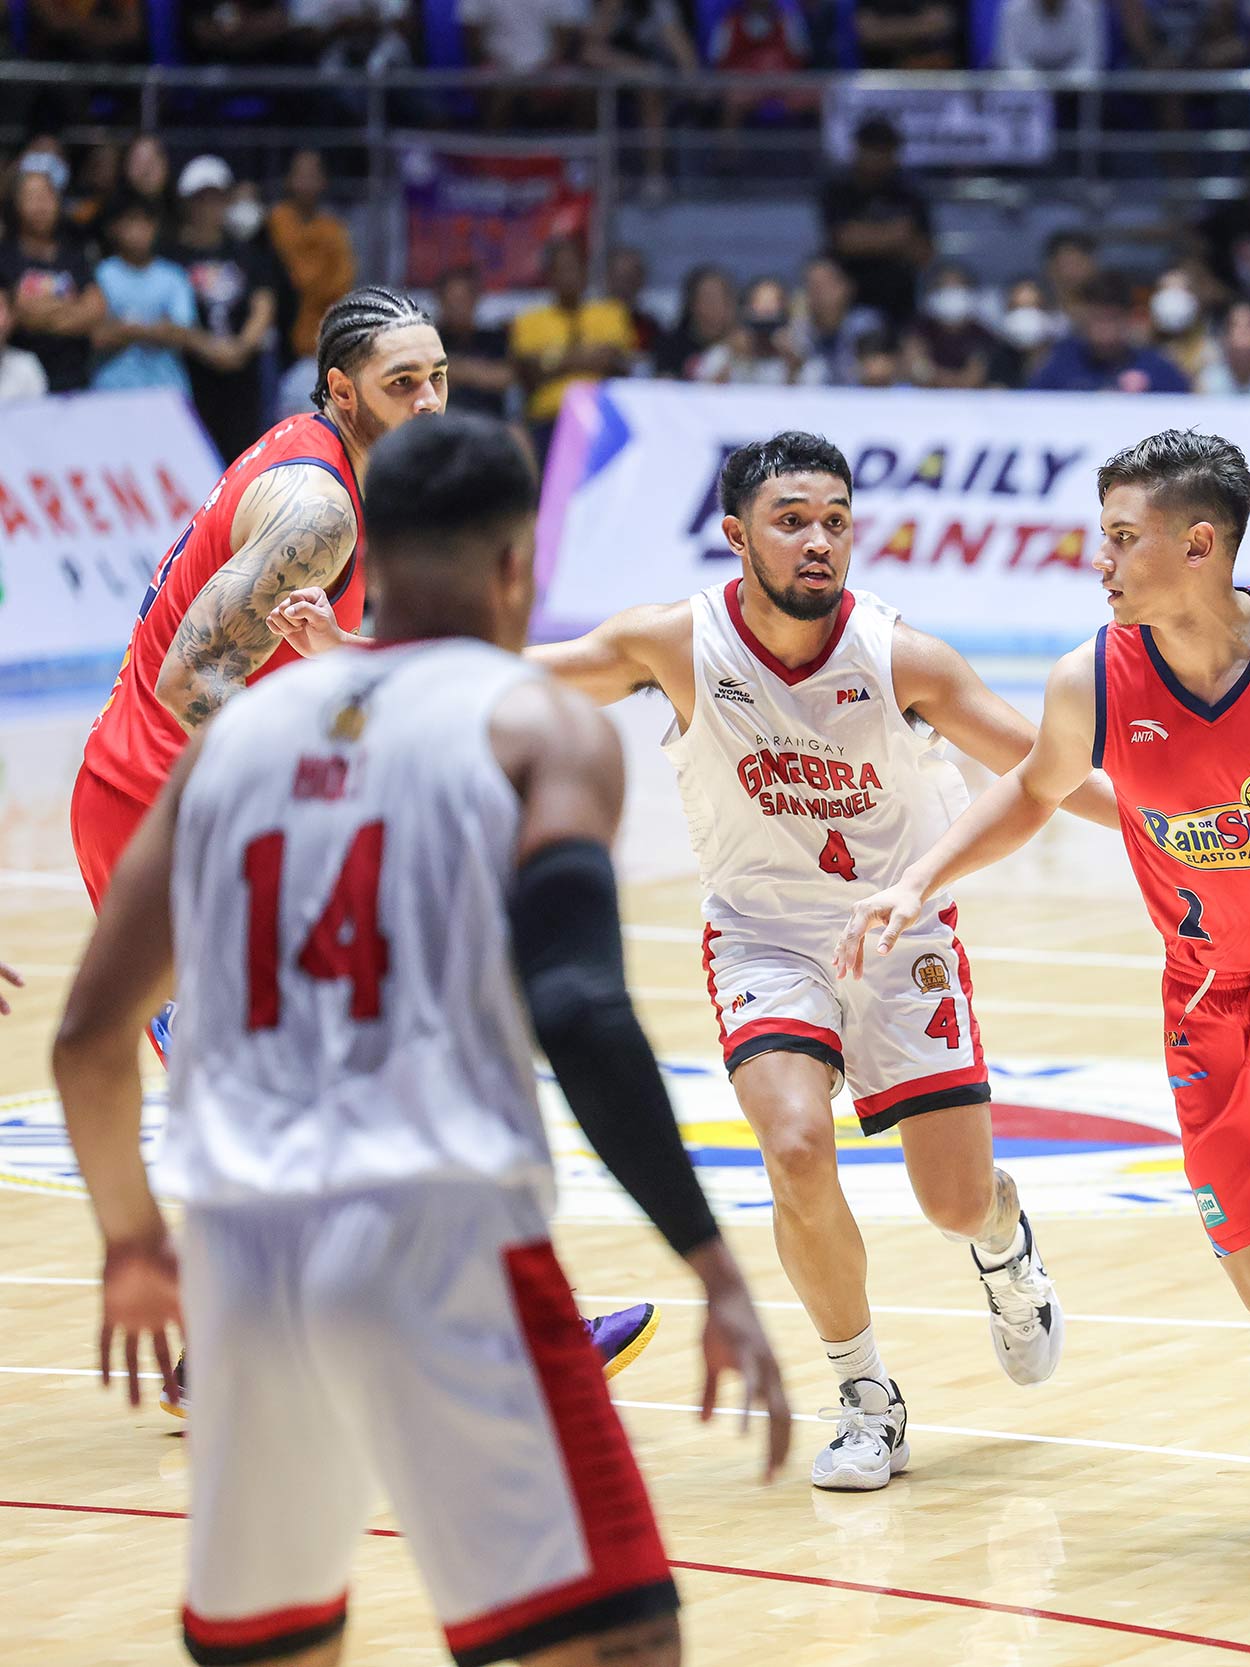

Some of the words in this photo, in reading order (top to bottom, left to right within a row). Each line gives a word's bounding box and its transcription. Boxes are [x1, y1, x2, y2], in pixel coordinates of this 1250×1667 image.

[850, 443, 1085, 495] DAILY
[852, 516, 1098, 573] ANTA
[714, 692, 755, 705] BALANCE
[717, 687, 750, 698] WORLD
[836, 687, 871, 705] PBA
[1130, 730, 1155, 744] ANTA
[758, 791, 808, 817] SAN
[804, 791, 878, 821] MIGUEL
[1137, 808, 1222, 852] Rain
[1197, 819, 1213, 830] OR
[818, 827, 859, 883] 4
[1185, 851, 1236, 865] ELASTO
[242, 820, 391, 1033] 14
[1174, 886, 1213, 944] 2
[923, 996, 961, 1050] 4
